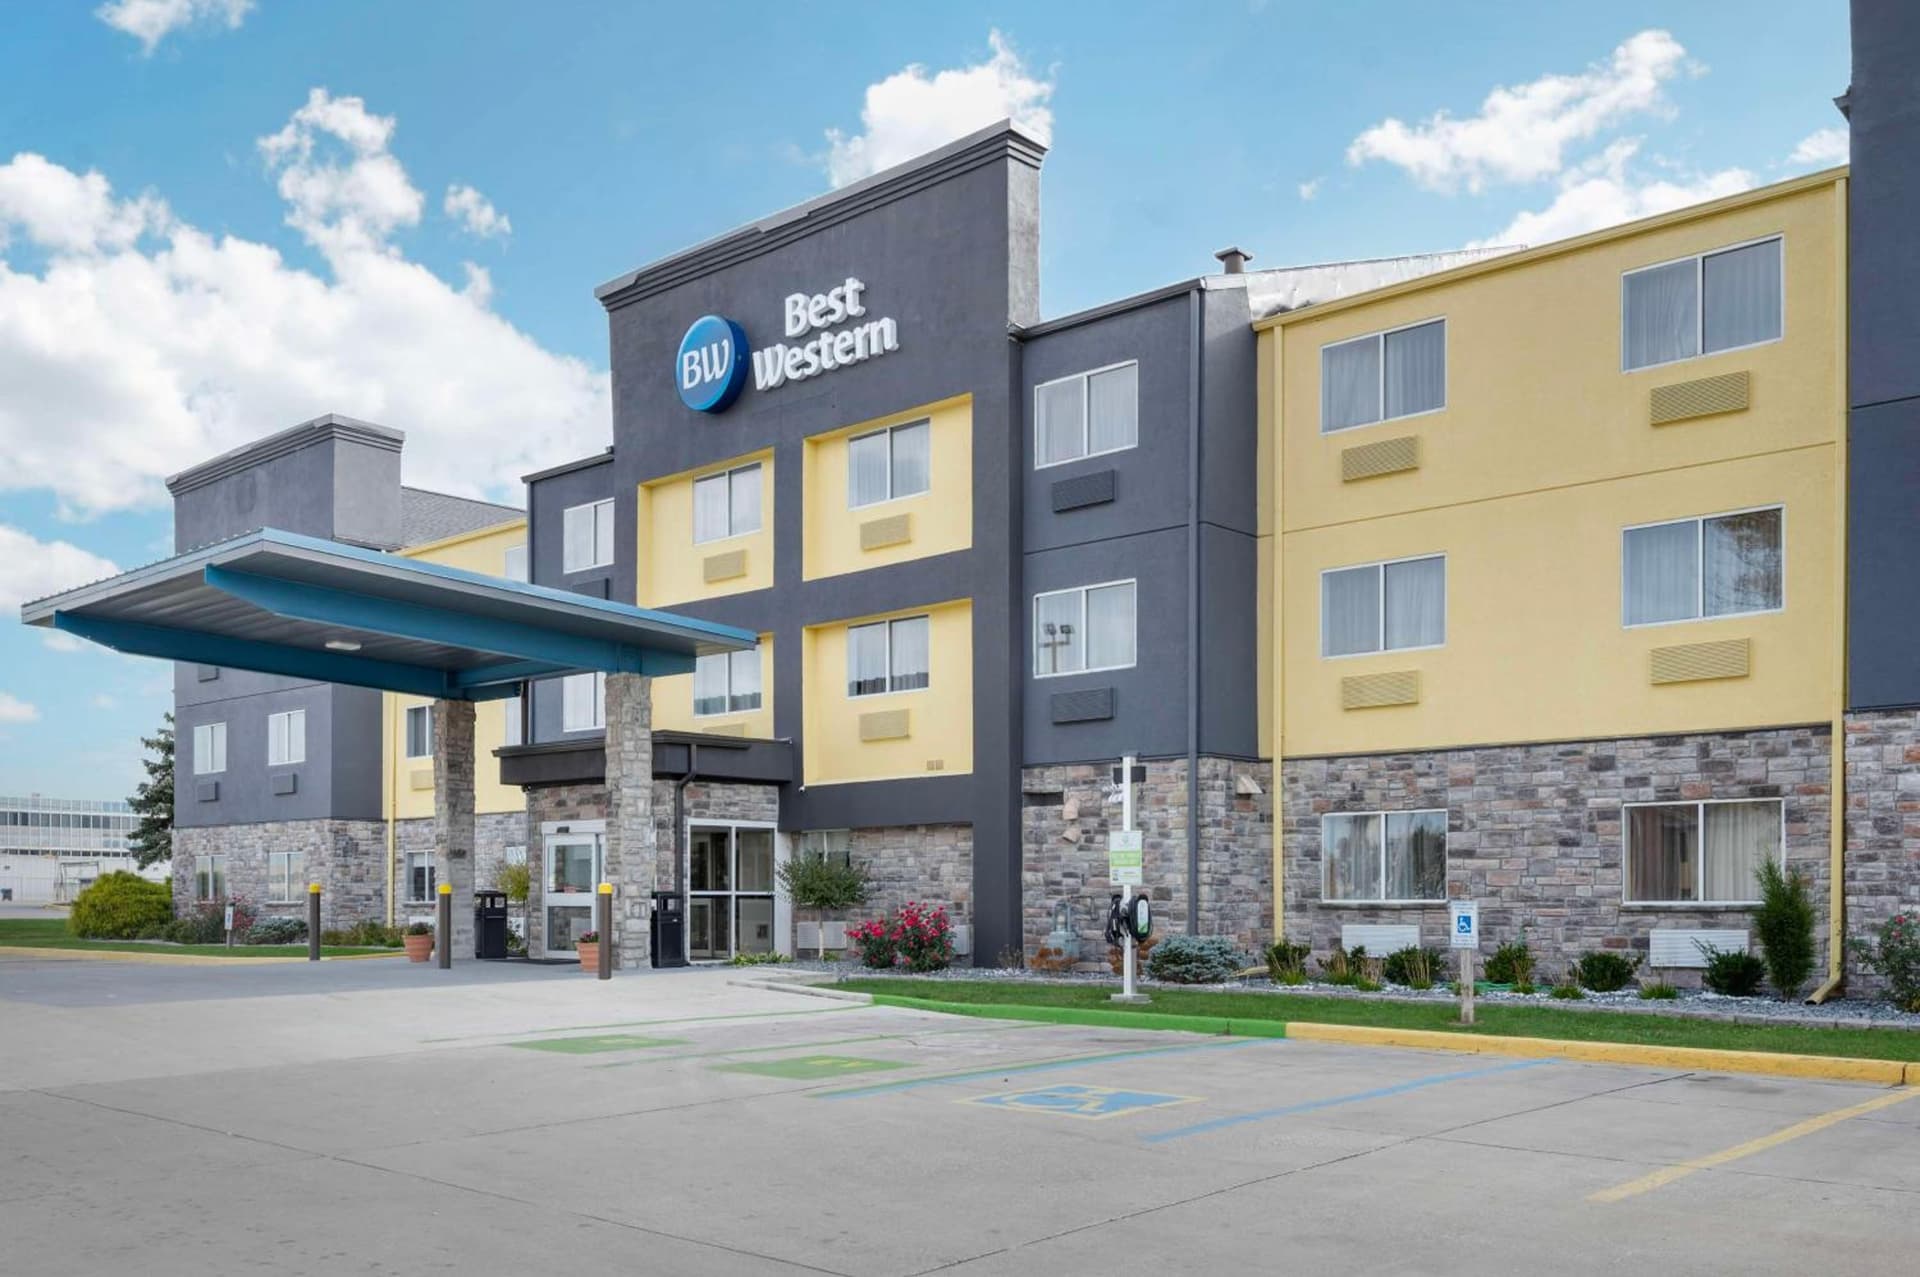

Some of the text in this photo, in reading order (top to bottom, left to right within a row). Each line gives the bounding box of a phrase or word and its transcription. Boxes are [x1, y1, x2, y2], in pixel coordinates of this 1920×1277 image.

[785, 277, 866, 337] Best
[682, 338, 729, 390] BW
[752, 317, 899, 391] Western
